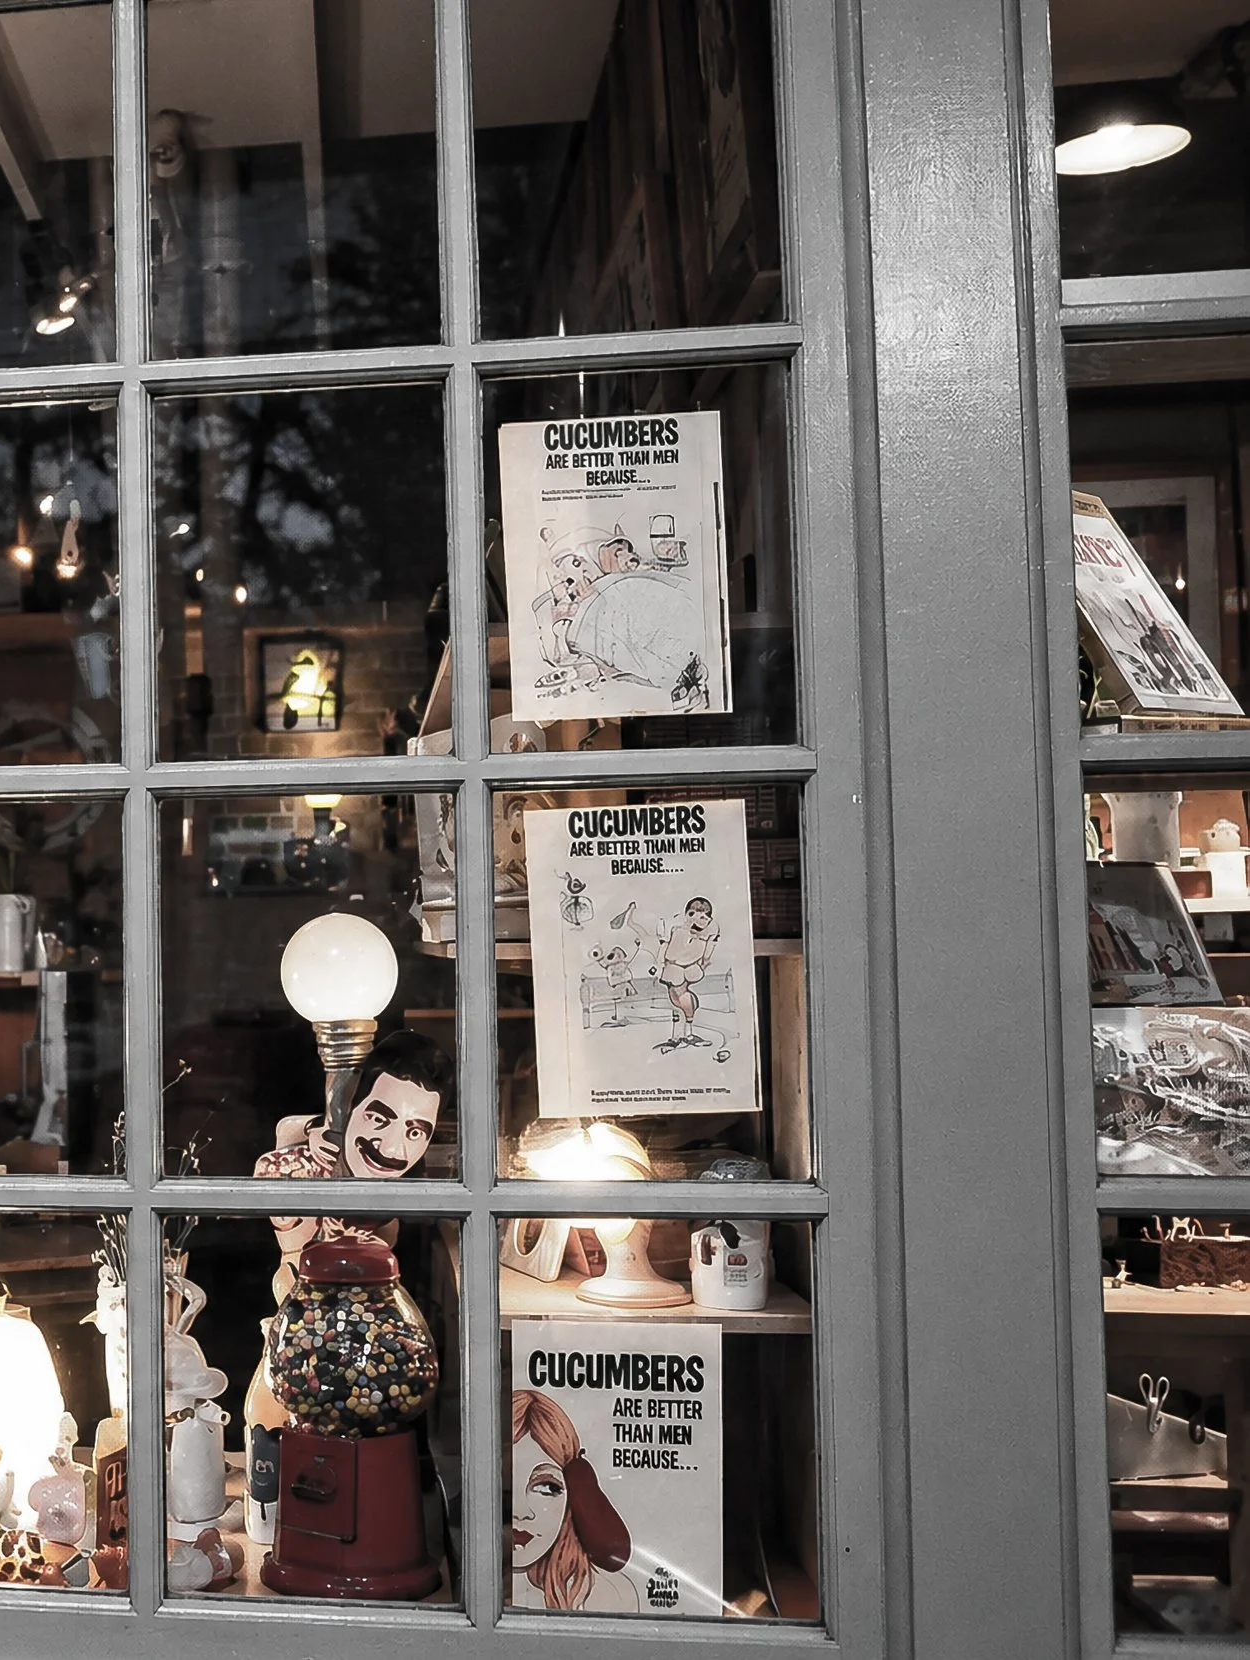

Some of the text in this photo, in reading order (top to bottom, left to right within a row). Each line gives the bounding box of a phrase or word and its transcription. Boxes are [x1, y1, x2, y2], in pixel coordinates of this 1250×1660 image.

[543, 418, 680, 451] CUCUMBERS
[545, 449, 679, 470] ARE BETTER THAN MEN
[568, 804, 707, 839] CUCUMBERS
[569, 837, 706, 857] ARE BETTER THAN MEN
[528, 1350, 705, 1393] CUCUMBERS
[612, 1398, 703, 1420] ARE BETTER
[613, 1423, 692, 1445] THAN MEN
[612, 1448, 699, 1471] BECAUSE...
